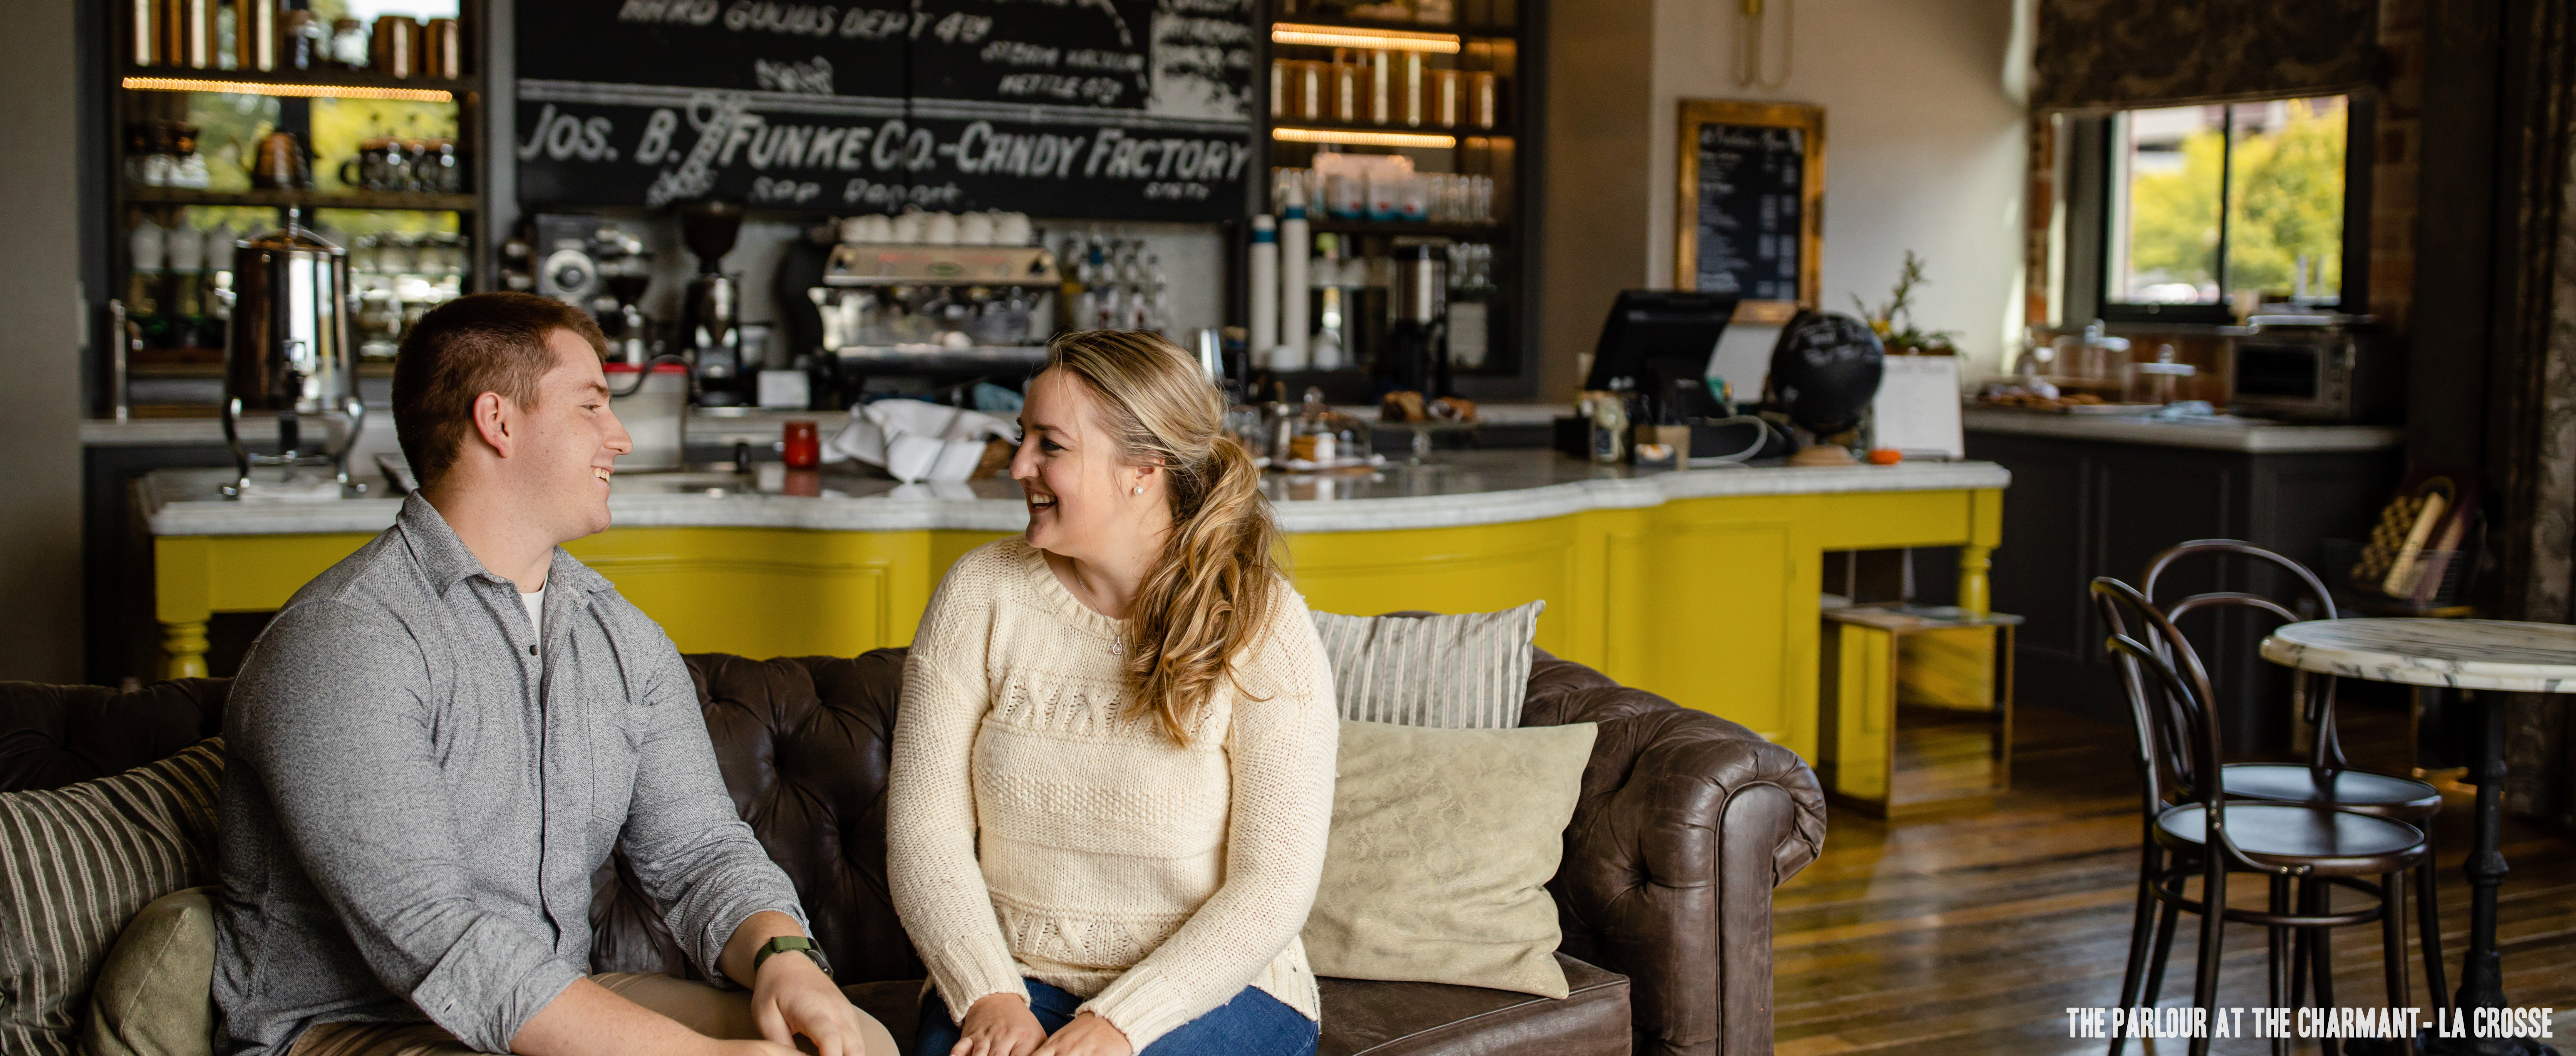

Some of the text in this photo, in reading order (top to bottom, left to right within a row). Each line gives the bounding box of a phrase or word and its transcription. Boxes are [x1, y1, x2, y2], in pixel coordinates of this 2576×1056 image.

[724, 0, 839, 37] GOODS
[839, 7, 935, 41] DEPT
[518, 103, 618, 162] JOS.
[635, 108, 680, 164] B.
[717, 116, 874, 171] FUNKE
[1083, 127, 1251, 180] FACTORY
